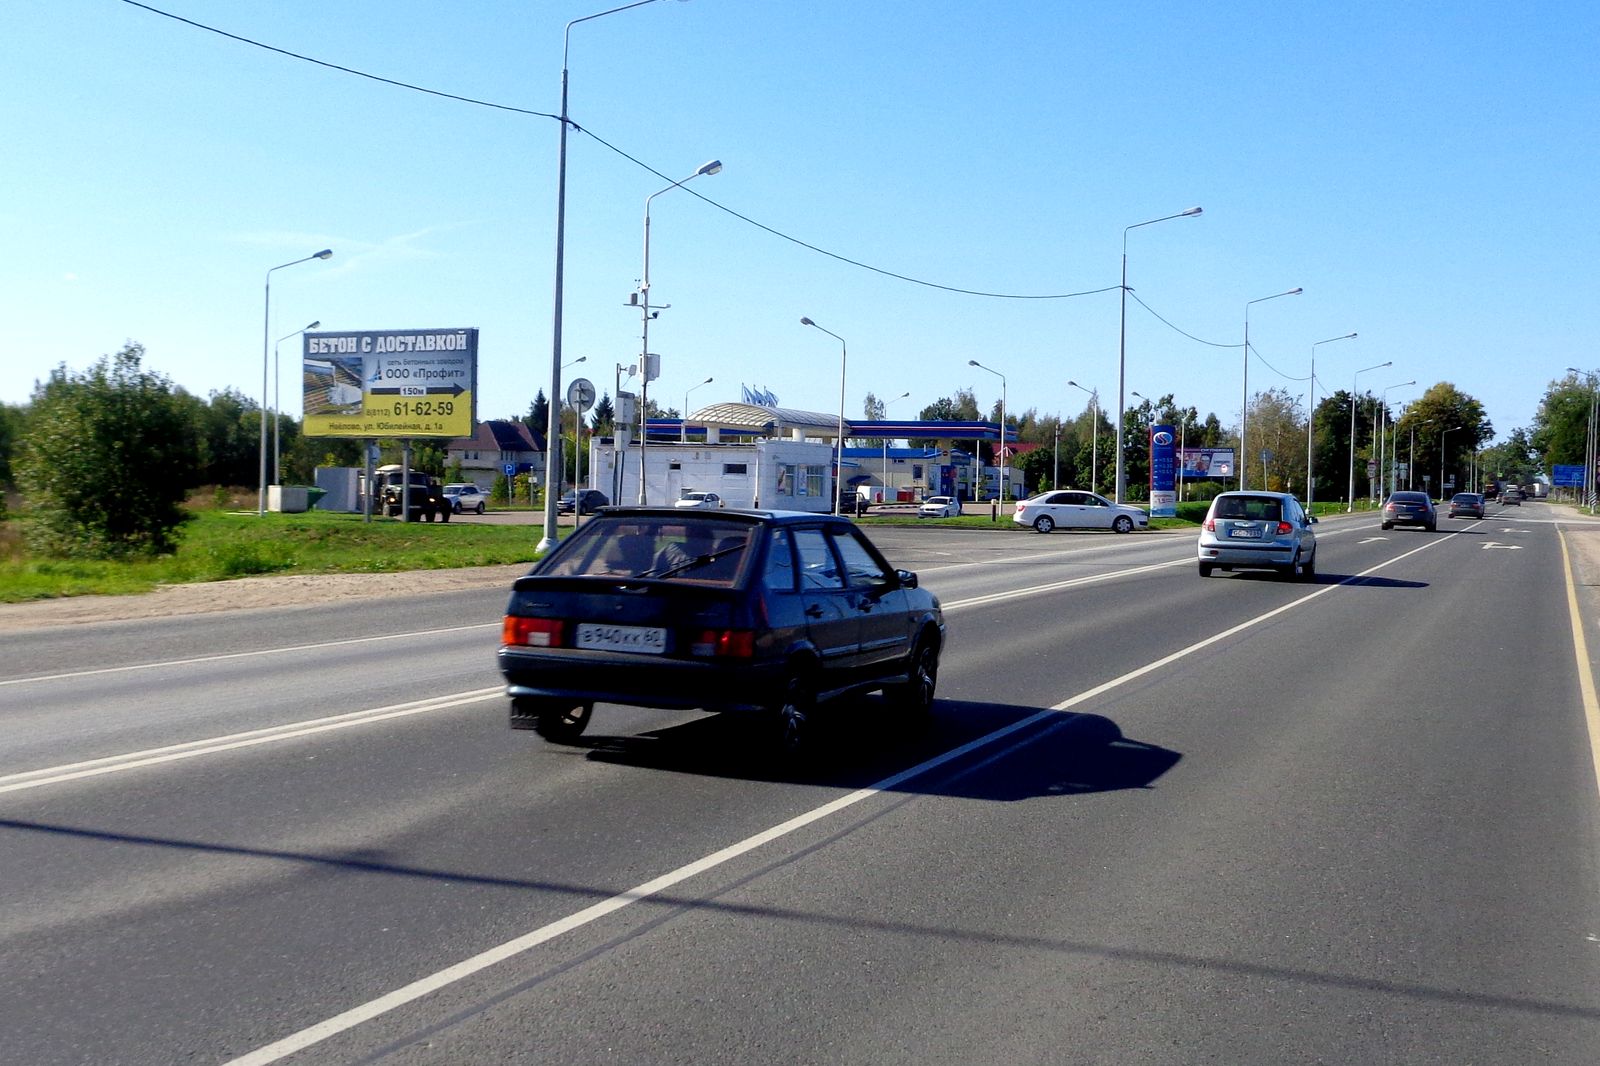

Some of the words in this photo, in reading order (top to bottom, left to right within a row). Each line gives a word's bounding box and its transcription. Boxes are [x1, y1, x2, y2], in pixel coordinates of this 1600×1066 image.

[309, 336, 357, 354] БЕТОН
[361, 335, 372, 353] С
[376, 331, 467, 353] ДОСТАВКОЙ
[386, 368, 410, 379] ООО
[413, 368, 465, 380] «Профит»
[402, 387, 425, 395] 150м
[394, 402, 454, 416] 61-62-59
